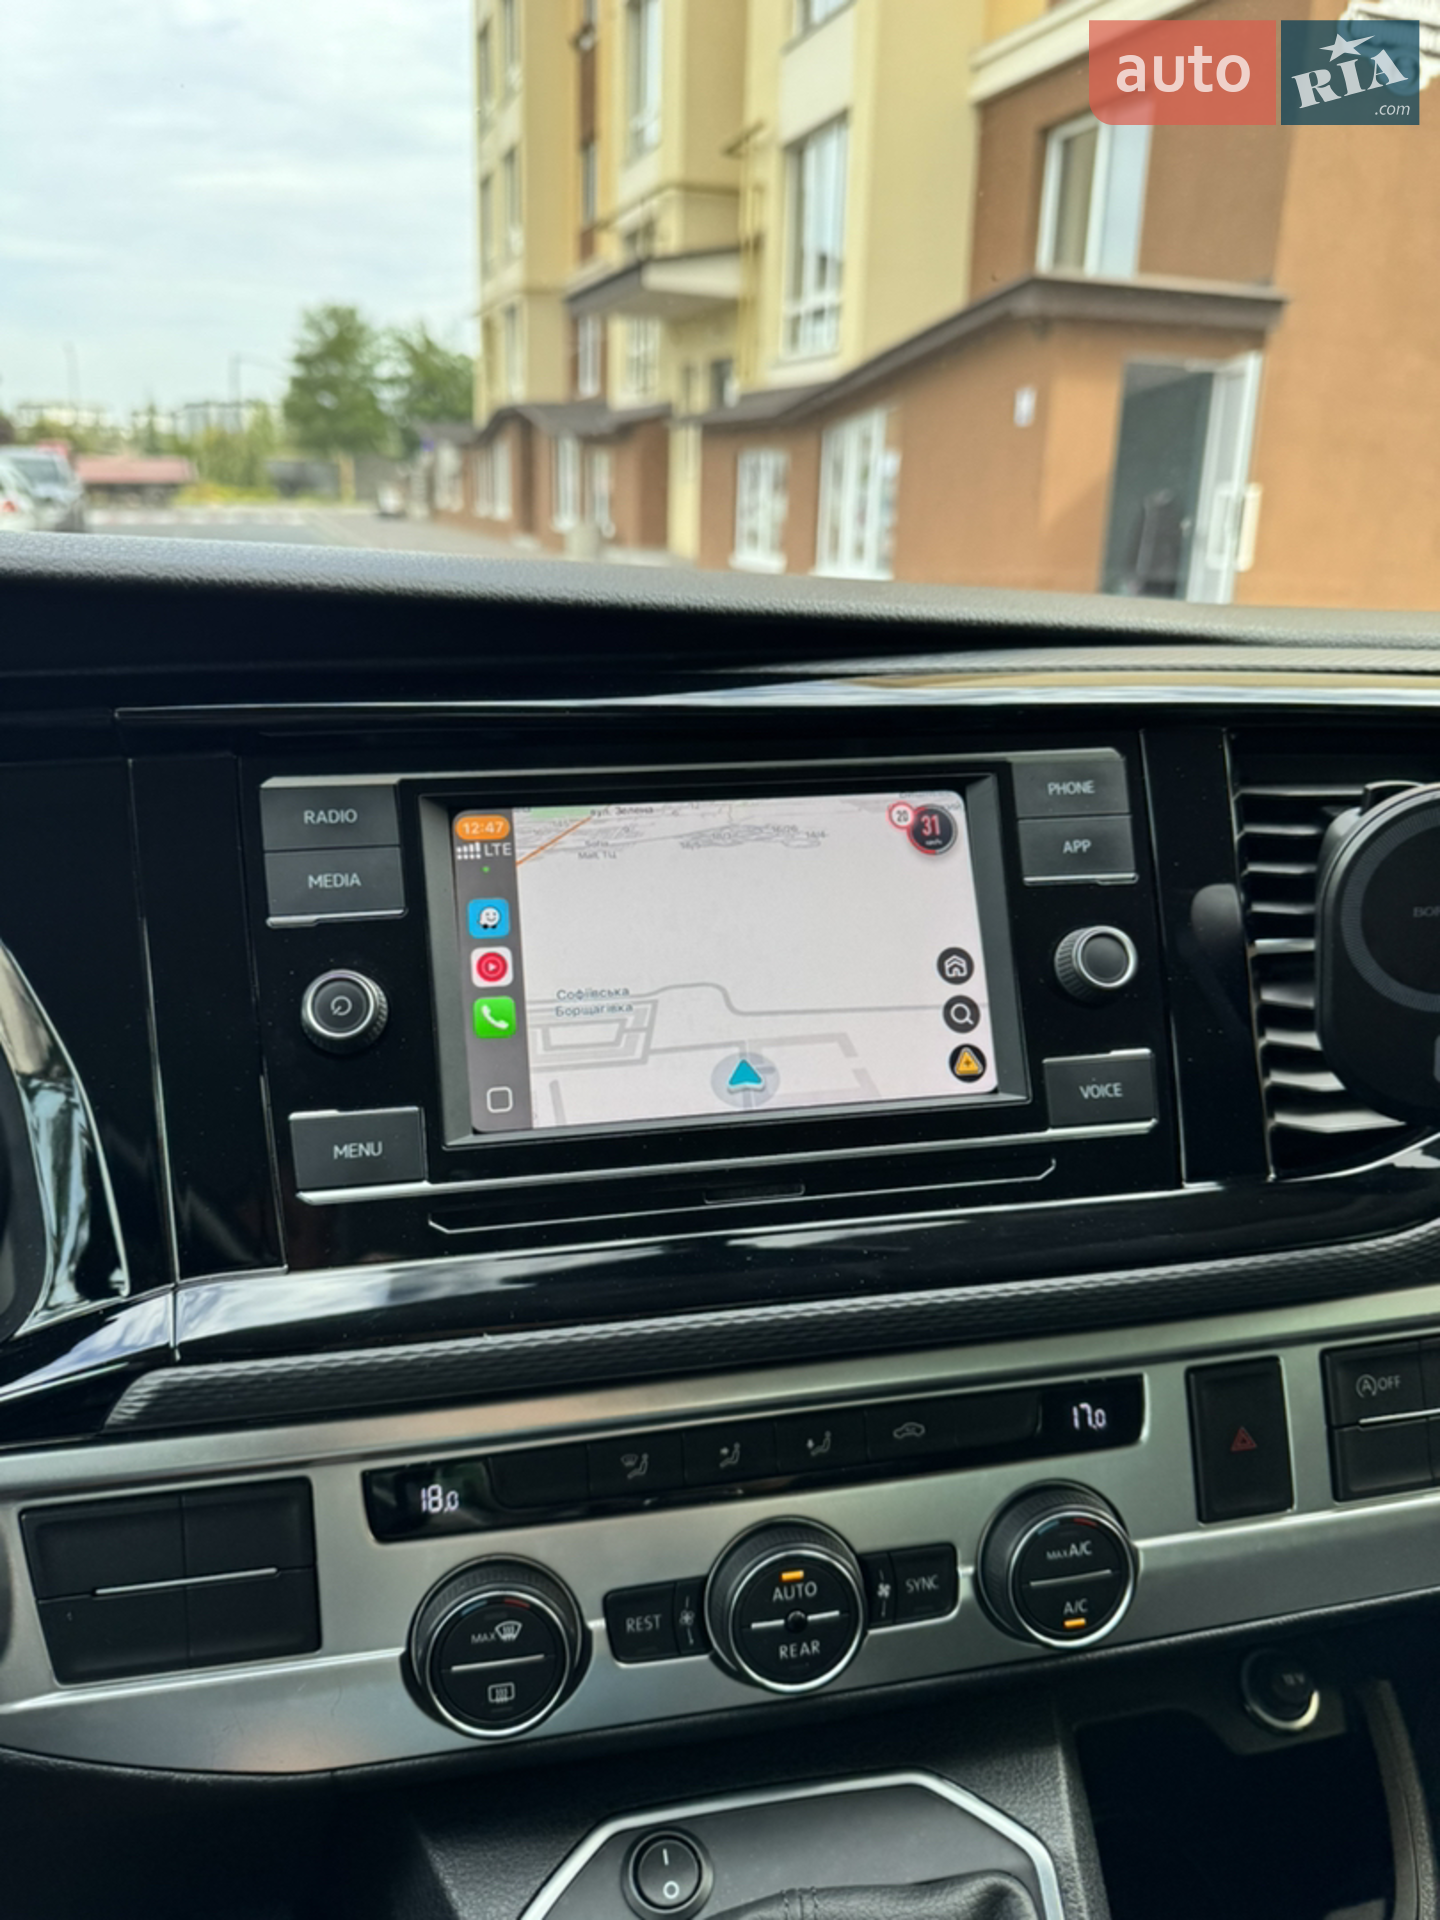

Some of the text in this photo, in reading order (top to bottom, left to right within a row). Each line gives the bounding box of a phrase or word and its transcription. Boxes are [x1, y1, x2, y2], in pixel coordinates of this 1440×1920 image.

[1047, 780, 1096, 796] PHONE
[303, 808, 358, 825] RADIO
[920, 814, 942, 836] 31
[462, 820, 505, 836] 12:47
[483, 842, 513, 857] LTE
[1062, 839, 1092, 855] APP
[307, 872, 362, 889] MEDIA
[1079, 1082, 1123, 1100] VOICE
[332, 1142, 383, 1160] MENU
[1376, 1374, 1402, 1392] OFF
[1068, 1540, 1093, 1557] A/C
[771, 1580, 819, 1604] AUTO
[904, 1573, 940, 1593] SYNC
[1062, 1597, 1089, 1617] A/C
[625, 1614, 662, 1634] REST
[470, 1632, 496, 1644] MAX
[777, 1638, 822, 1660] REAR
